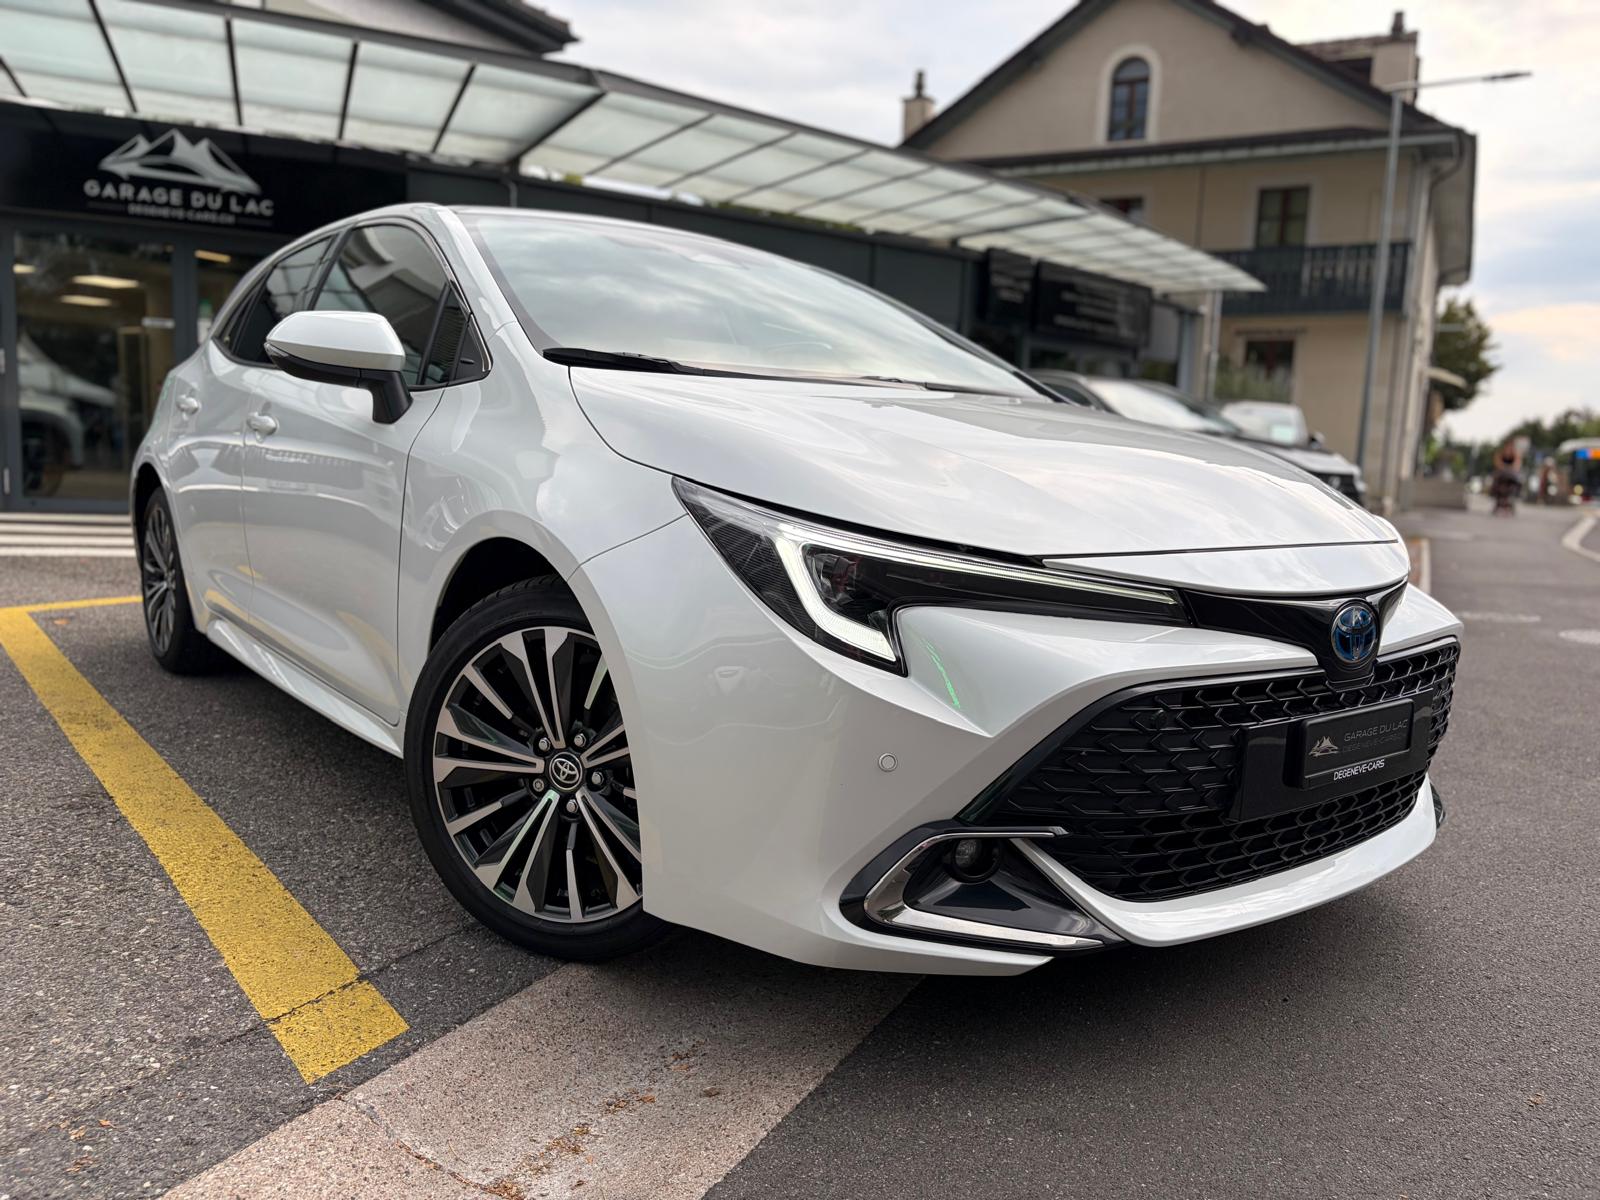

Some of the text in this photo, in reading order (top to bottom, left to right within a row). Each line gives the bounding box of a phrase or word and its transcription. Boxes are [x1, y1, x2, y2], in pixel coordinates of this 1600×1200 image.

[83, 179, 274, 216] GARAGE DU LAC
[1344, 719, 1408, 741] GARAGE DU LAC
[1333, 759, 1385, 780] DEGENEVE-CARS
